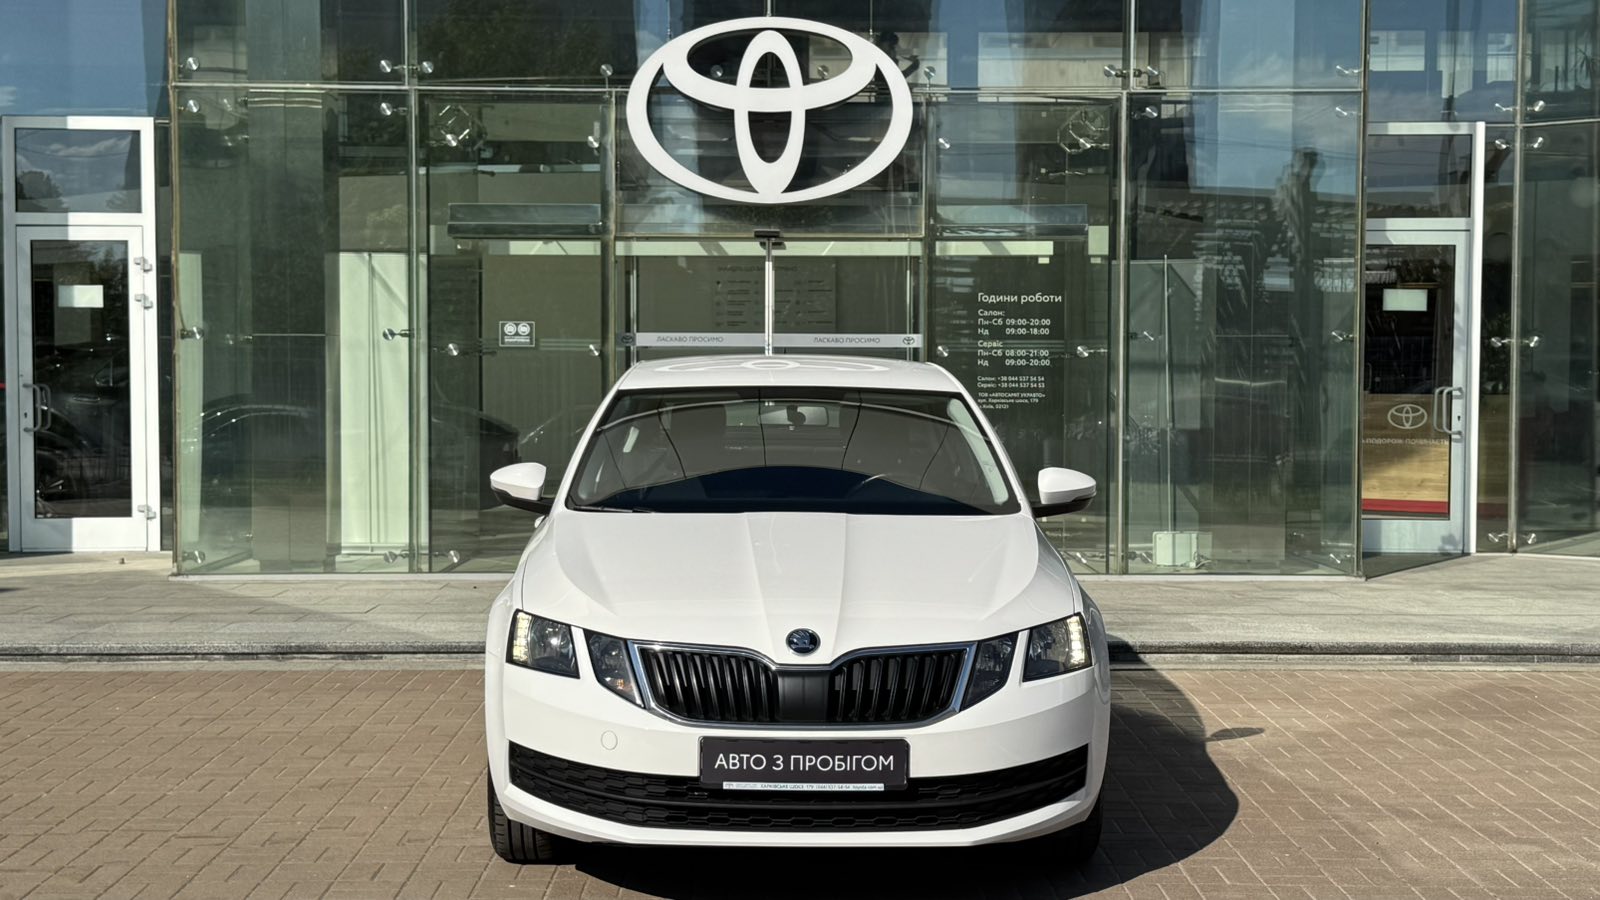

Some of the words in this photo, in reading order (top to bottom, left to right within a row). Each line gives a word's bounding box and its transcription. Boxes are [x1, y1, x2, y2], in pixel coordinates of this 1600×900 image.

[978, 292, 1018, 304] Години
[1020, 292, 1062, 304] роботи
[714, 753, 767, 770] АВТО
[772, 754, 784, 771] З
[790, 754, 894, 771] ПРОБІГОМ
